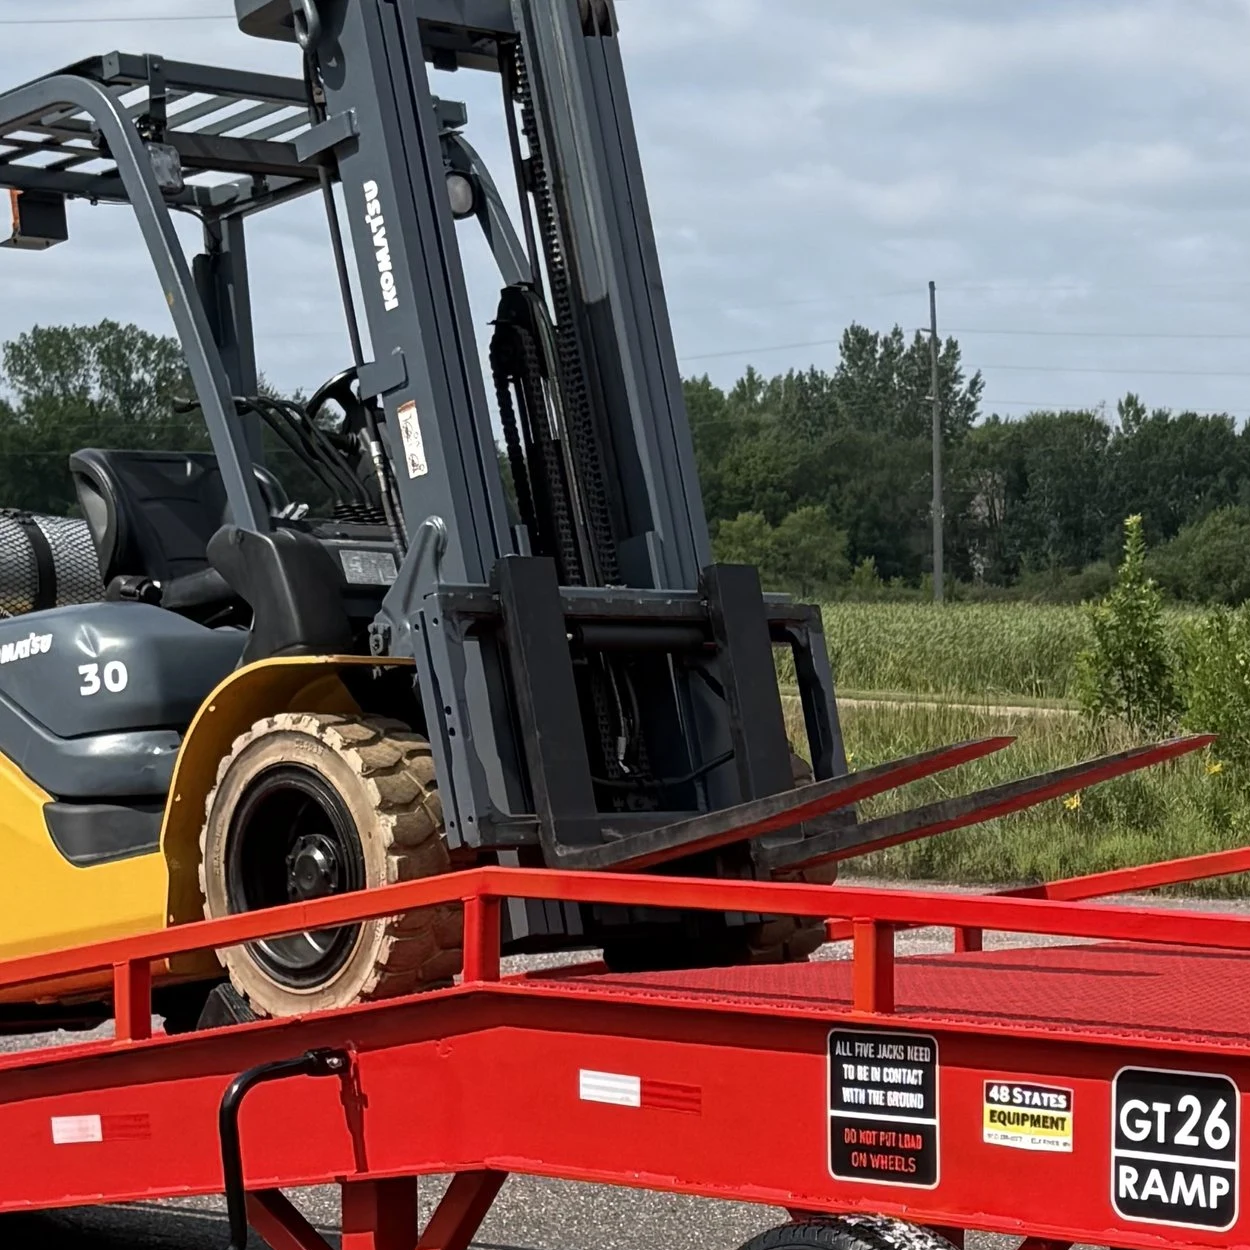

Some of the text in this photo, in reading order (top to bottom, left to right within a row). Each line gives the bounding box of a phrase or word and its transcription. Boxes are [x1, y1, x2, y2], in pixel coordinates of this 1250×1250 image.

[363, 180, 399, 312] KOMATSU
[0, 632, 53, 664] MATSU
[78, 660, 128, 696] 30
[835, 1040, 931, 1062] ALL FIVE JACKS NEED
[843, 1064, 923, 1085] TO BE IN CONTACT
[842, 1087, 924, 1109] WITH THE GROUND
[989, 1085, 1067, 1109] 48 STATES
[989, 1109, 1067, 1131] EQUIPMENT
[1119, 1094, 1231, 1150] GT26
[844, 1127, 922, 1150] DO NOT PUT LOAD
[851, 1151, 917, 1173] ON WHEELS
[1119, 1164, 1230, 1209] RAMP
